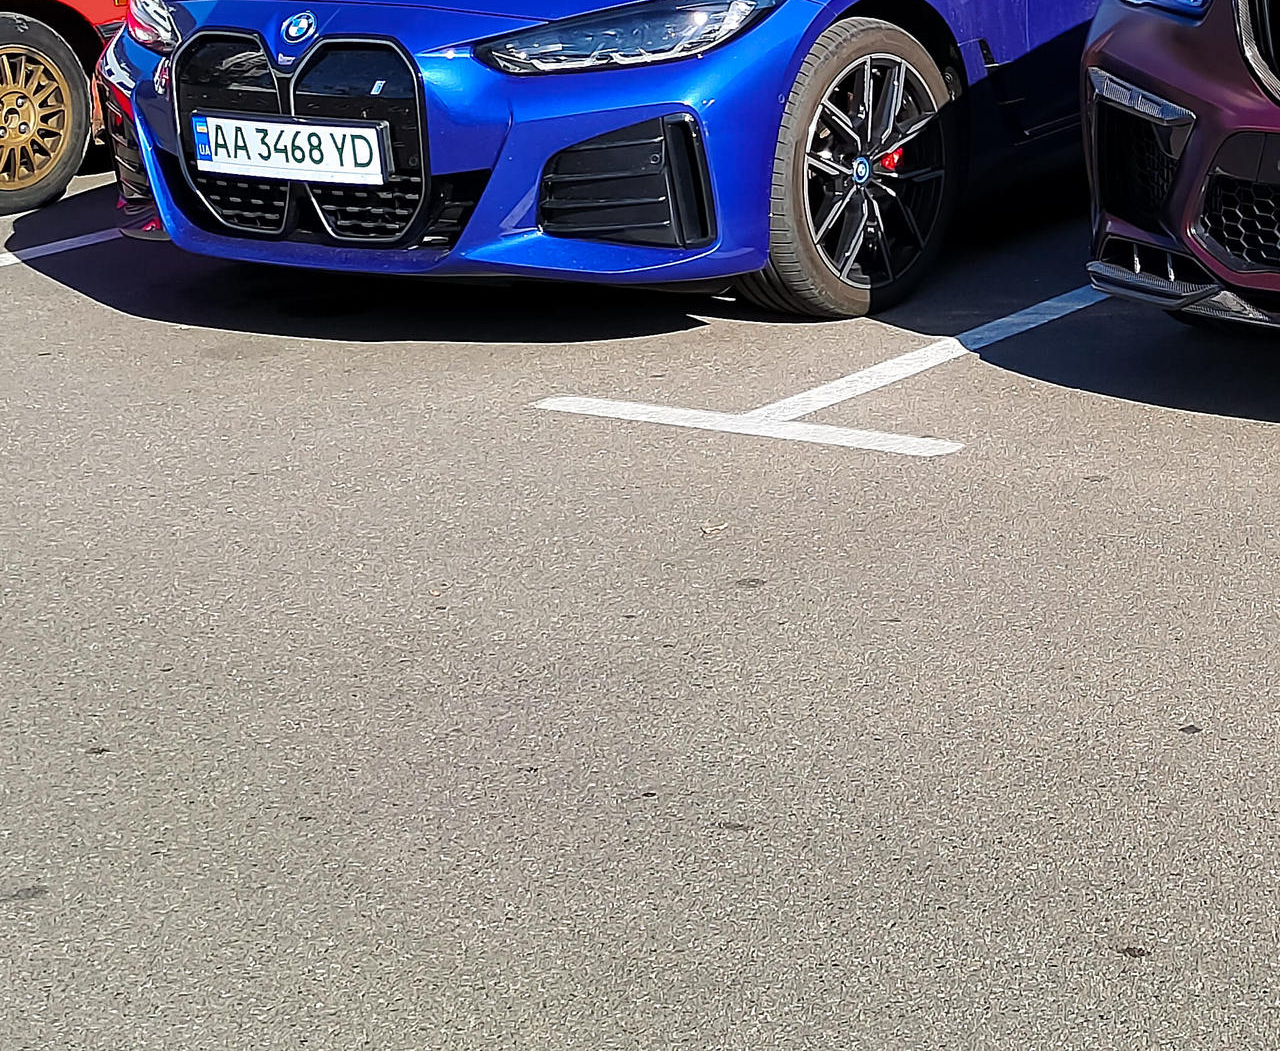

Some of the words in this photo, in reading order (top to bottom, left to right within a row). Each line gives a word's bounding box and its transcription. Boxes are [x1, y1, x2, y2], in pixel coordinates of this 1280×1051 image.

[198, 143, 211, 156] UA
[214, 124, 252, 160] AA
[255, 128, 324, 164] 3468
[329, 133, 374, 168] YD
